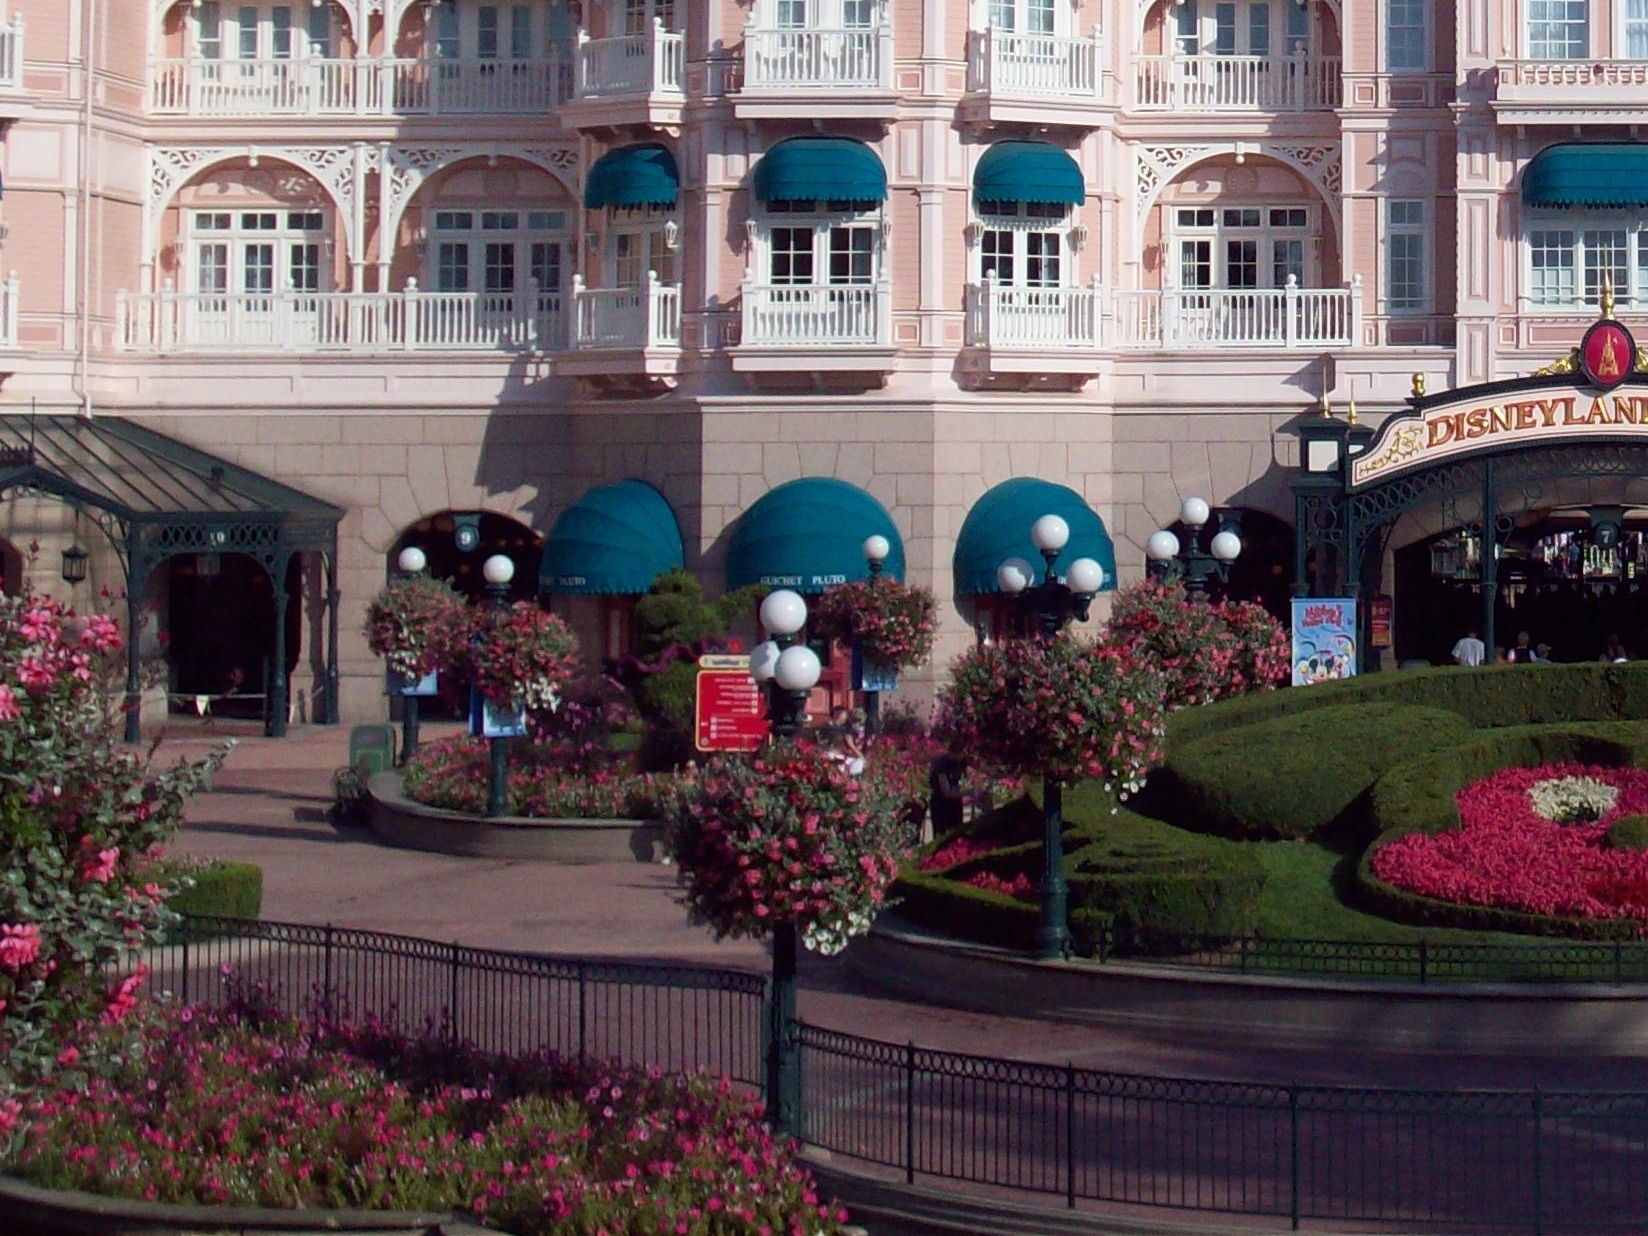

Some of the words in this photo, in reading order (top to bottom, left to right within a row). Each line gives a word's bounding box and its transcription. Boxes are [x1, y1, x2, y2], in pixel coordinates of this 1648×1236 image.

[1601, 530, 1610, 544] 7
[760, 575, 803, 586] GUICHET
[811, 574, 846, 585] PLUTO
